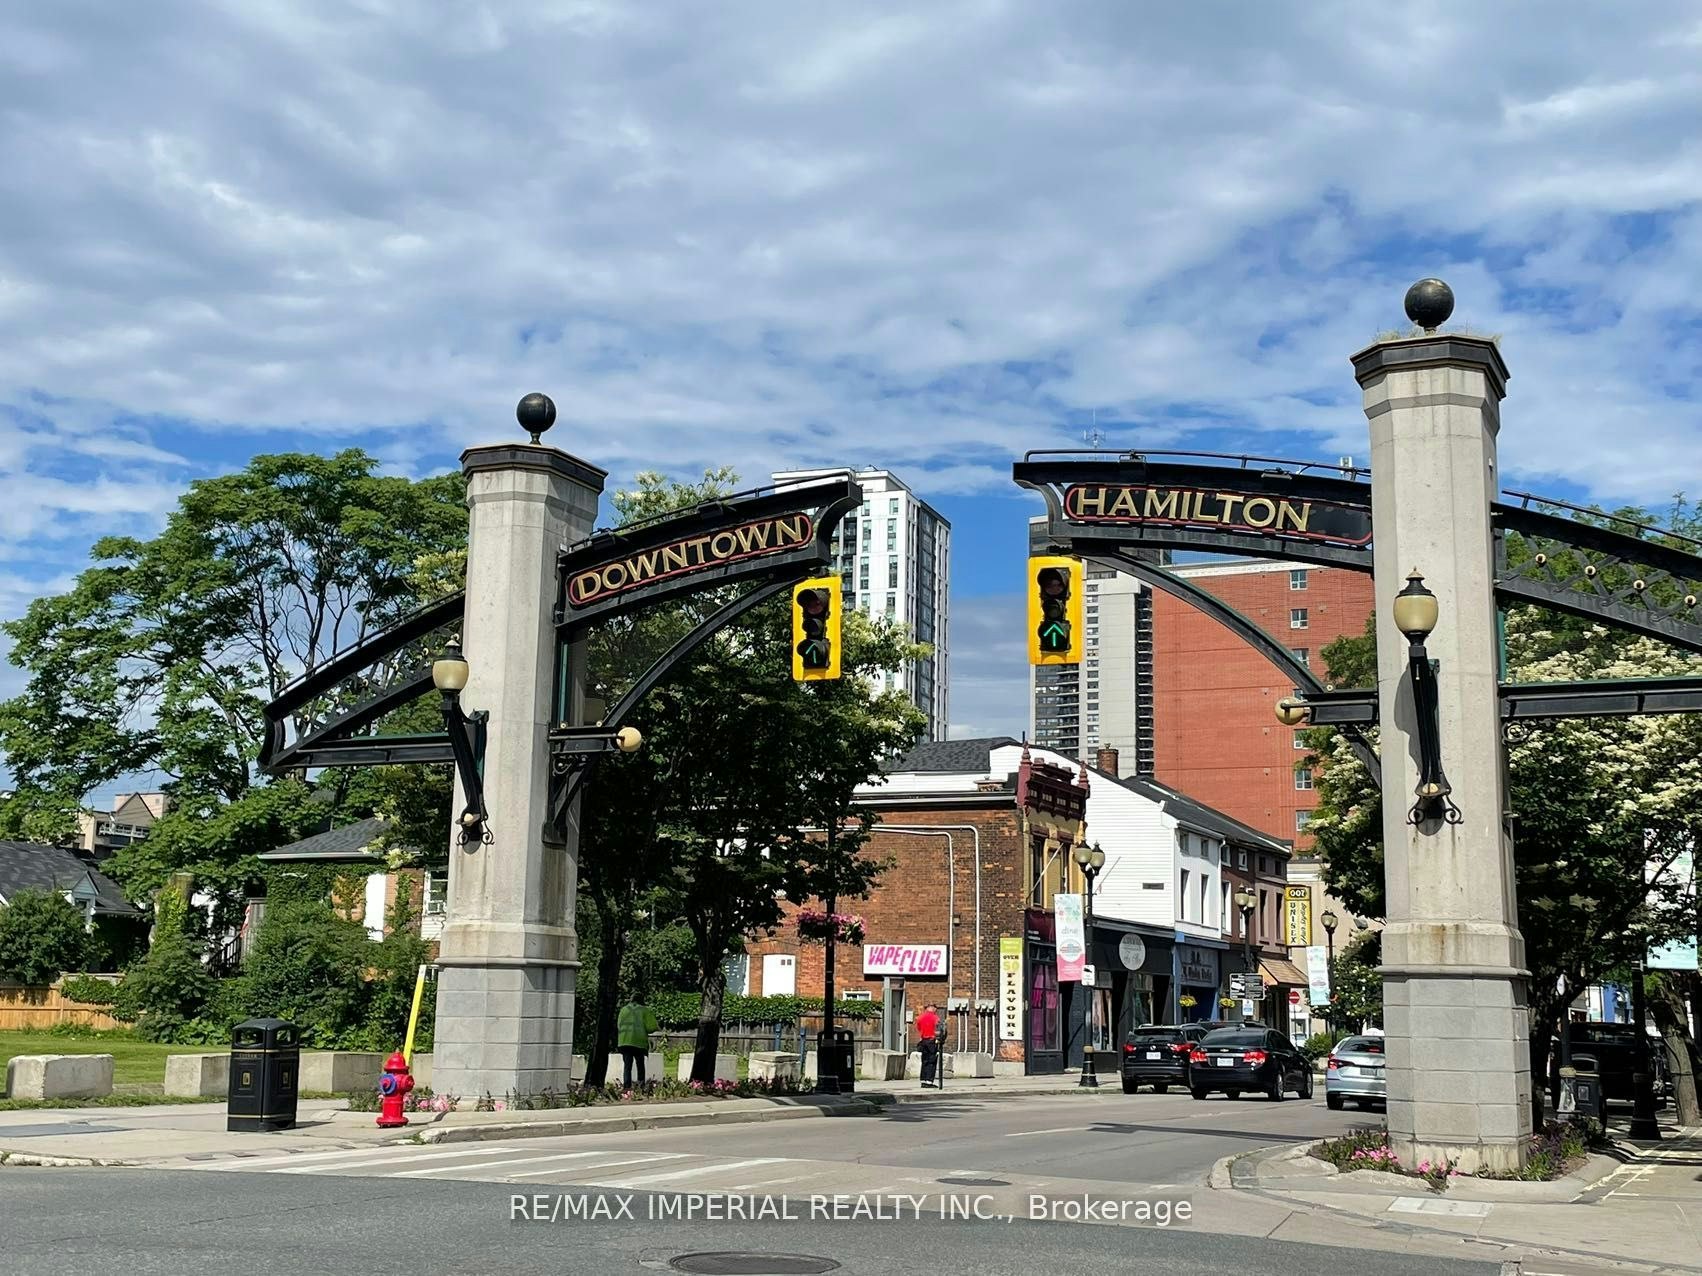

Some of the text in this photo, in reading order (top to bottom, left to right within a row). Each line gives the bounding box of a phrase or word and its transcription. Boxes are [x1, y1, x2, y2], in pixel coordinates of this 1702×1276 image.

[1076, 487, 1312, 532] HAMILTON
[576, 515, 803, 600] DOWNTOWN
[1002, 961, 1020, 971] 50
[1006, 972, 1016, 1037] FLAVOURS
